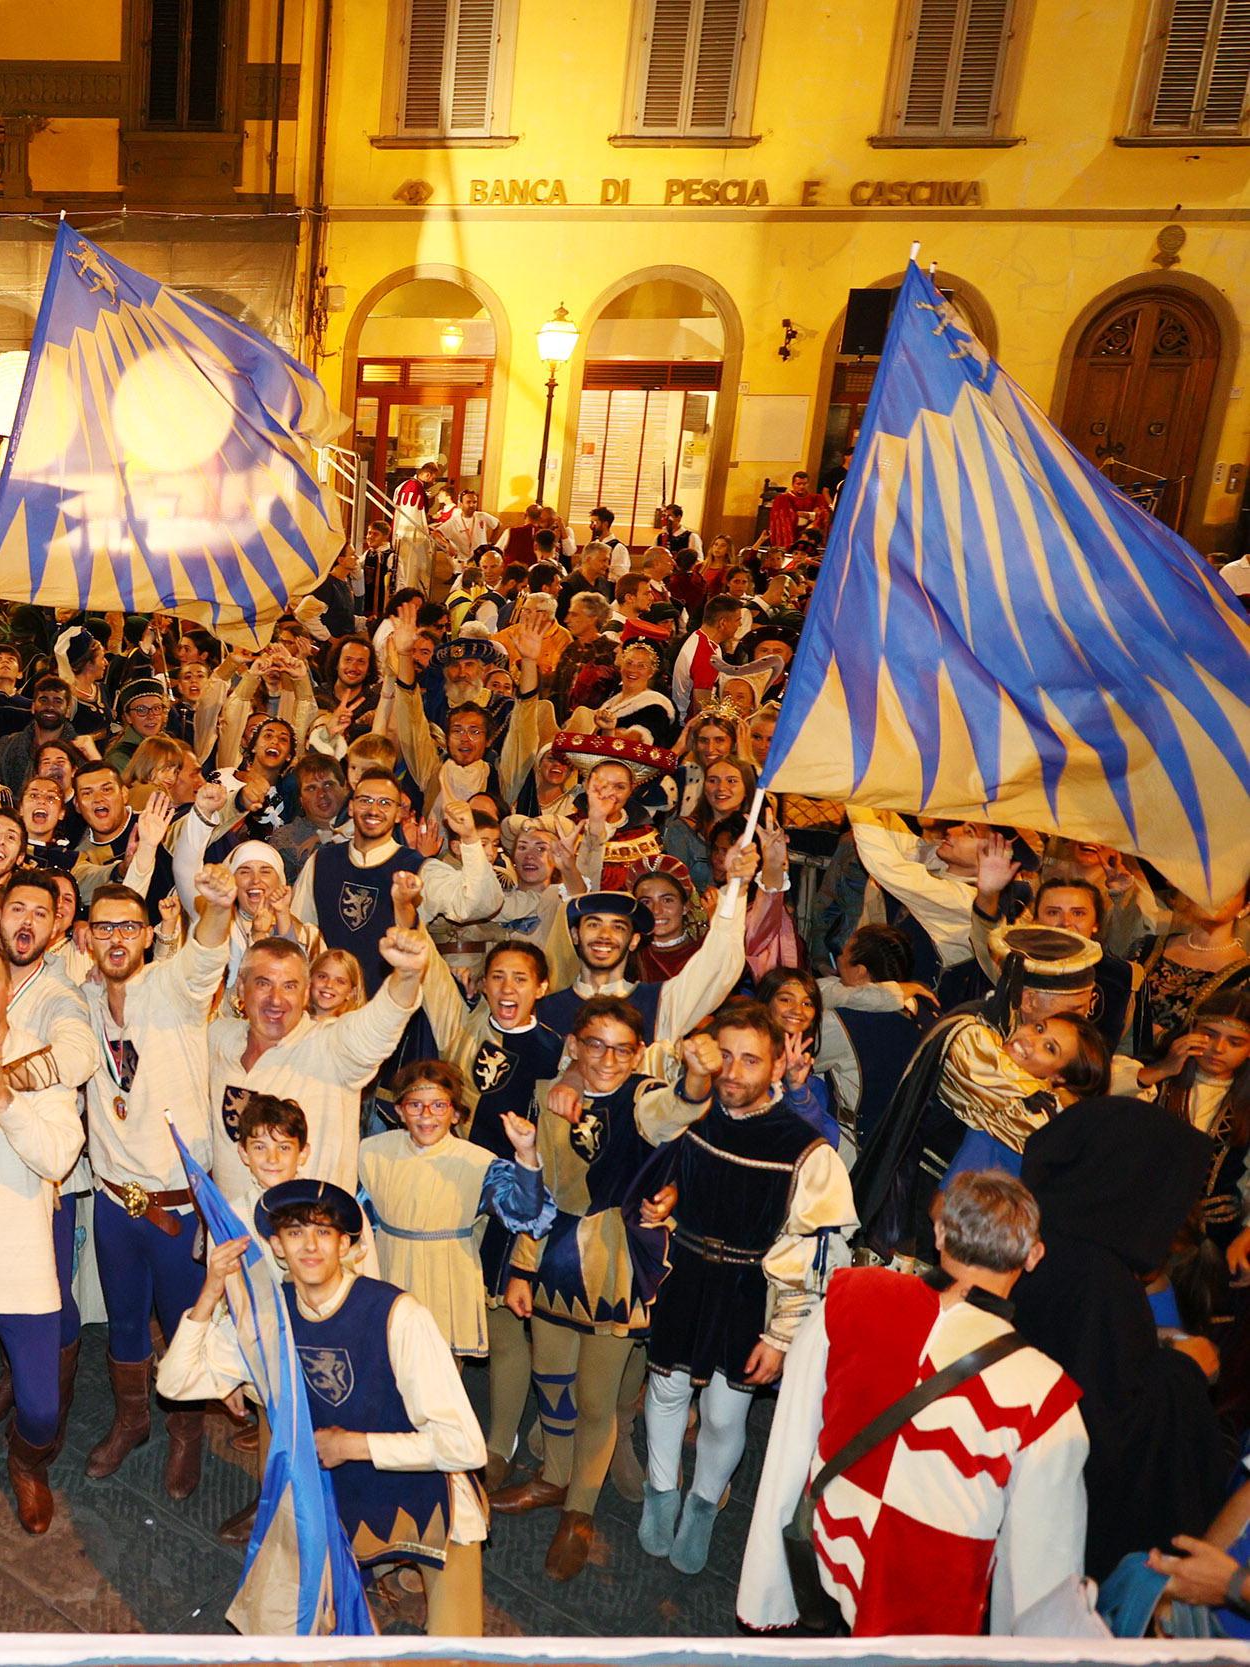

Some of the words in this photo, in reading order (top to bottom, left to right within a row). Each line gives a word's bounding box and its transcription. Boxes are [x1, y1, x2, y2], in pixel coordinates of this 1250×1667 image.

[469, 179, 568, 205] BANCA
[600, 178, 631, 205] DI
[663, 178, 769, 206] PESCIA
[801, 180, 822, 206] E
[850, 180, 982, 206] CASCINA
